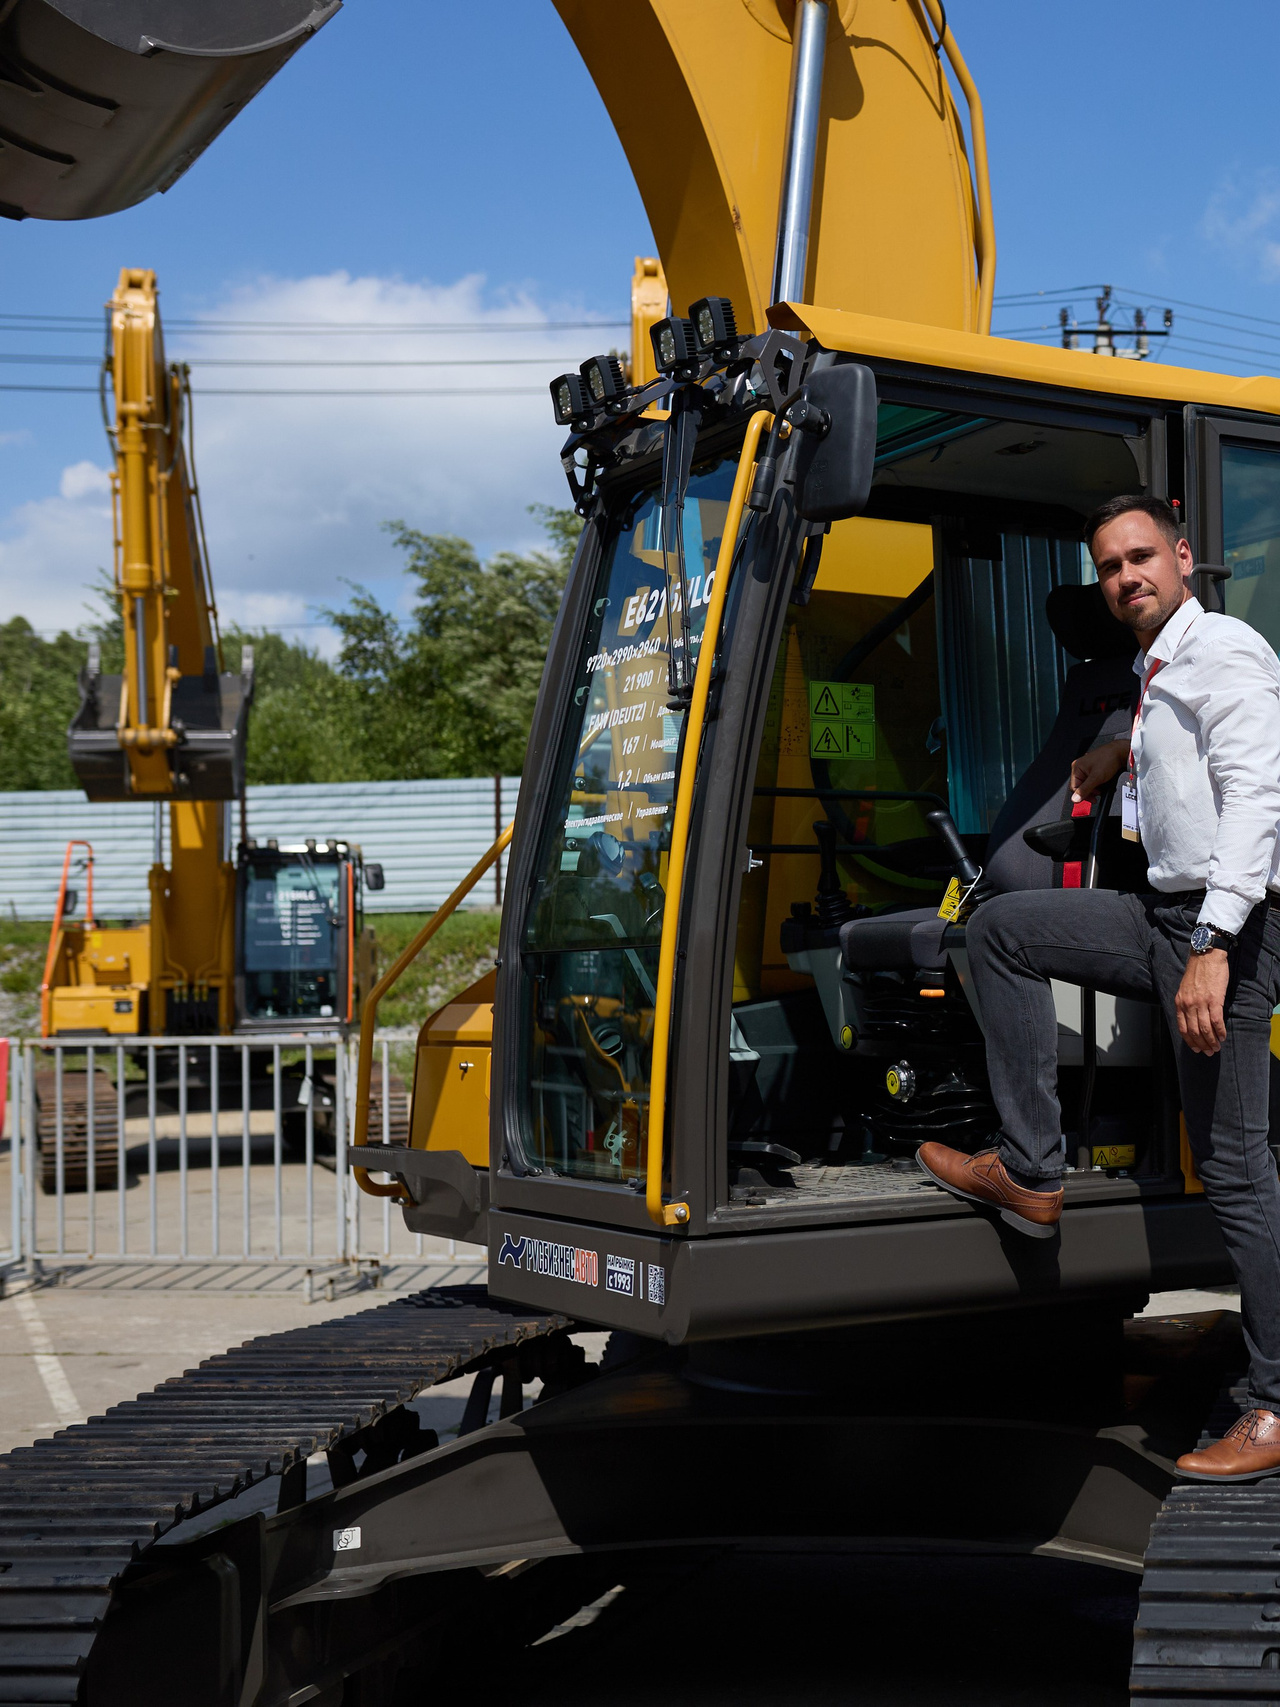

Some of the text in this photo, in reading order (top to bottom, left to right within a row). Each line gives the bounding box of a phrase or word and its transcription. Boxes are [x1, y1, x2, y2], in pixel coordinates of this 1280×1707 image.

[622, 734, 640, 756] 167
[617, 767, 631, 791] 1,2
[526, 1238, 599, 1287] РУСБИЗНЕСАВТО
[613, 1273, 631, 1291] 1993
